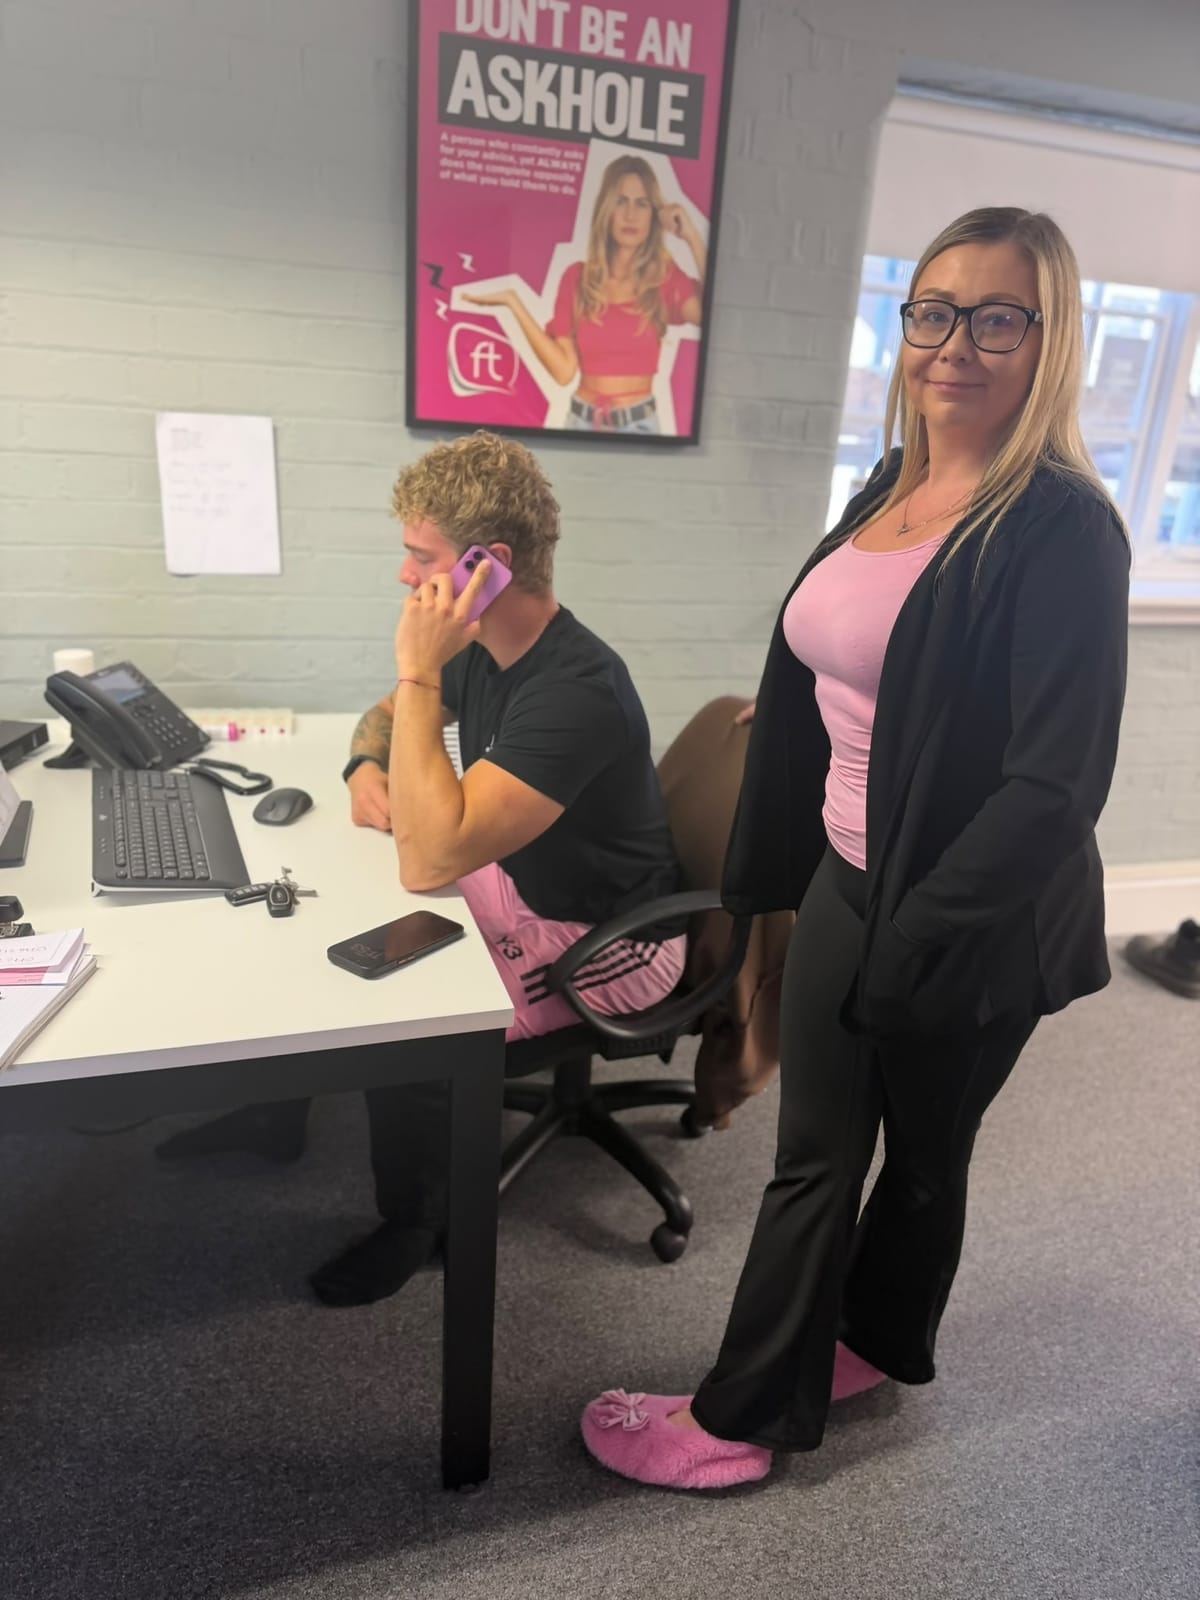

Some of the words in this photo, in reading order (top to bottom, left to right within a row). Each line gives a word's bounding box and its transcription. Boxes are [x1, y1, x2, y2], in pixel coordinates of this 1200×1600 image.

[456, 0, 570, 49] DON'T
[579, 6, 628, 59] BE
[636, 17, 693, 69] AN
[446, 49, 690, 147] ASKHOLE
[439, 144, 455, 156] for
[457, 149, 481, 160] your
[519, 156, 536, 167] yet
[537, 158, 582, 172] ALWAYS
[440, 132, 449, 142] A
[451, 134, 486, 147] person
[488, 137, 510, 150] who
[511, 142, 562, 159] constantly
[439, 158, 466, 169] does
[467, 160, 484, 171] the
[485, 163, 531, 178] complete
[533, 168, 576, 183] opposite
[439, 170, 451, 180] of
[453, 172, 478, 184] what
[480, 176, 498, 187] you
[500, 177, 521, 188] told
[522, 180, 547, 192] them
[549, 182, 560, 193] to
